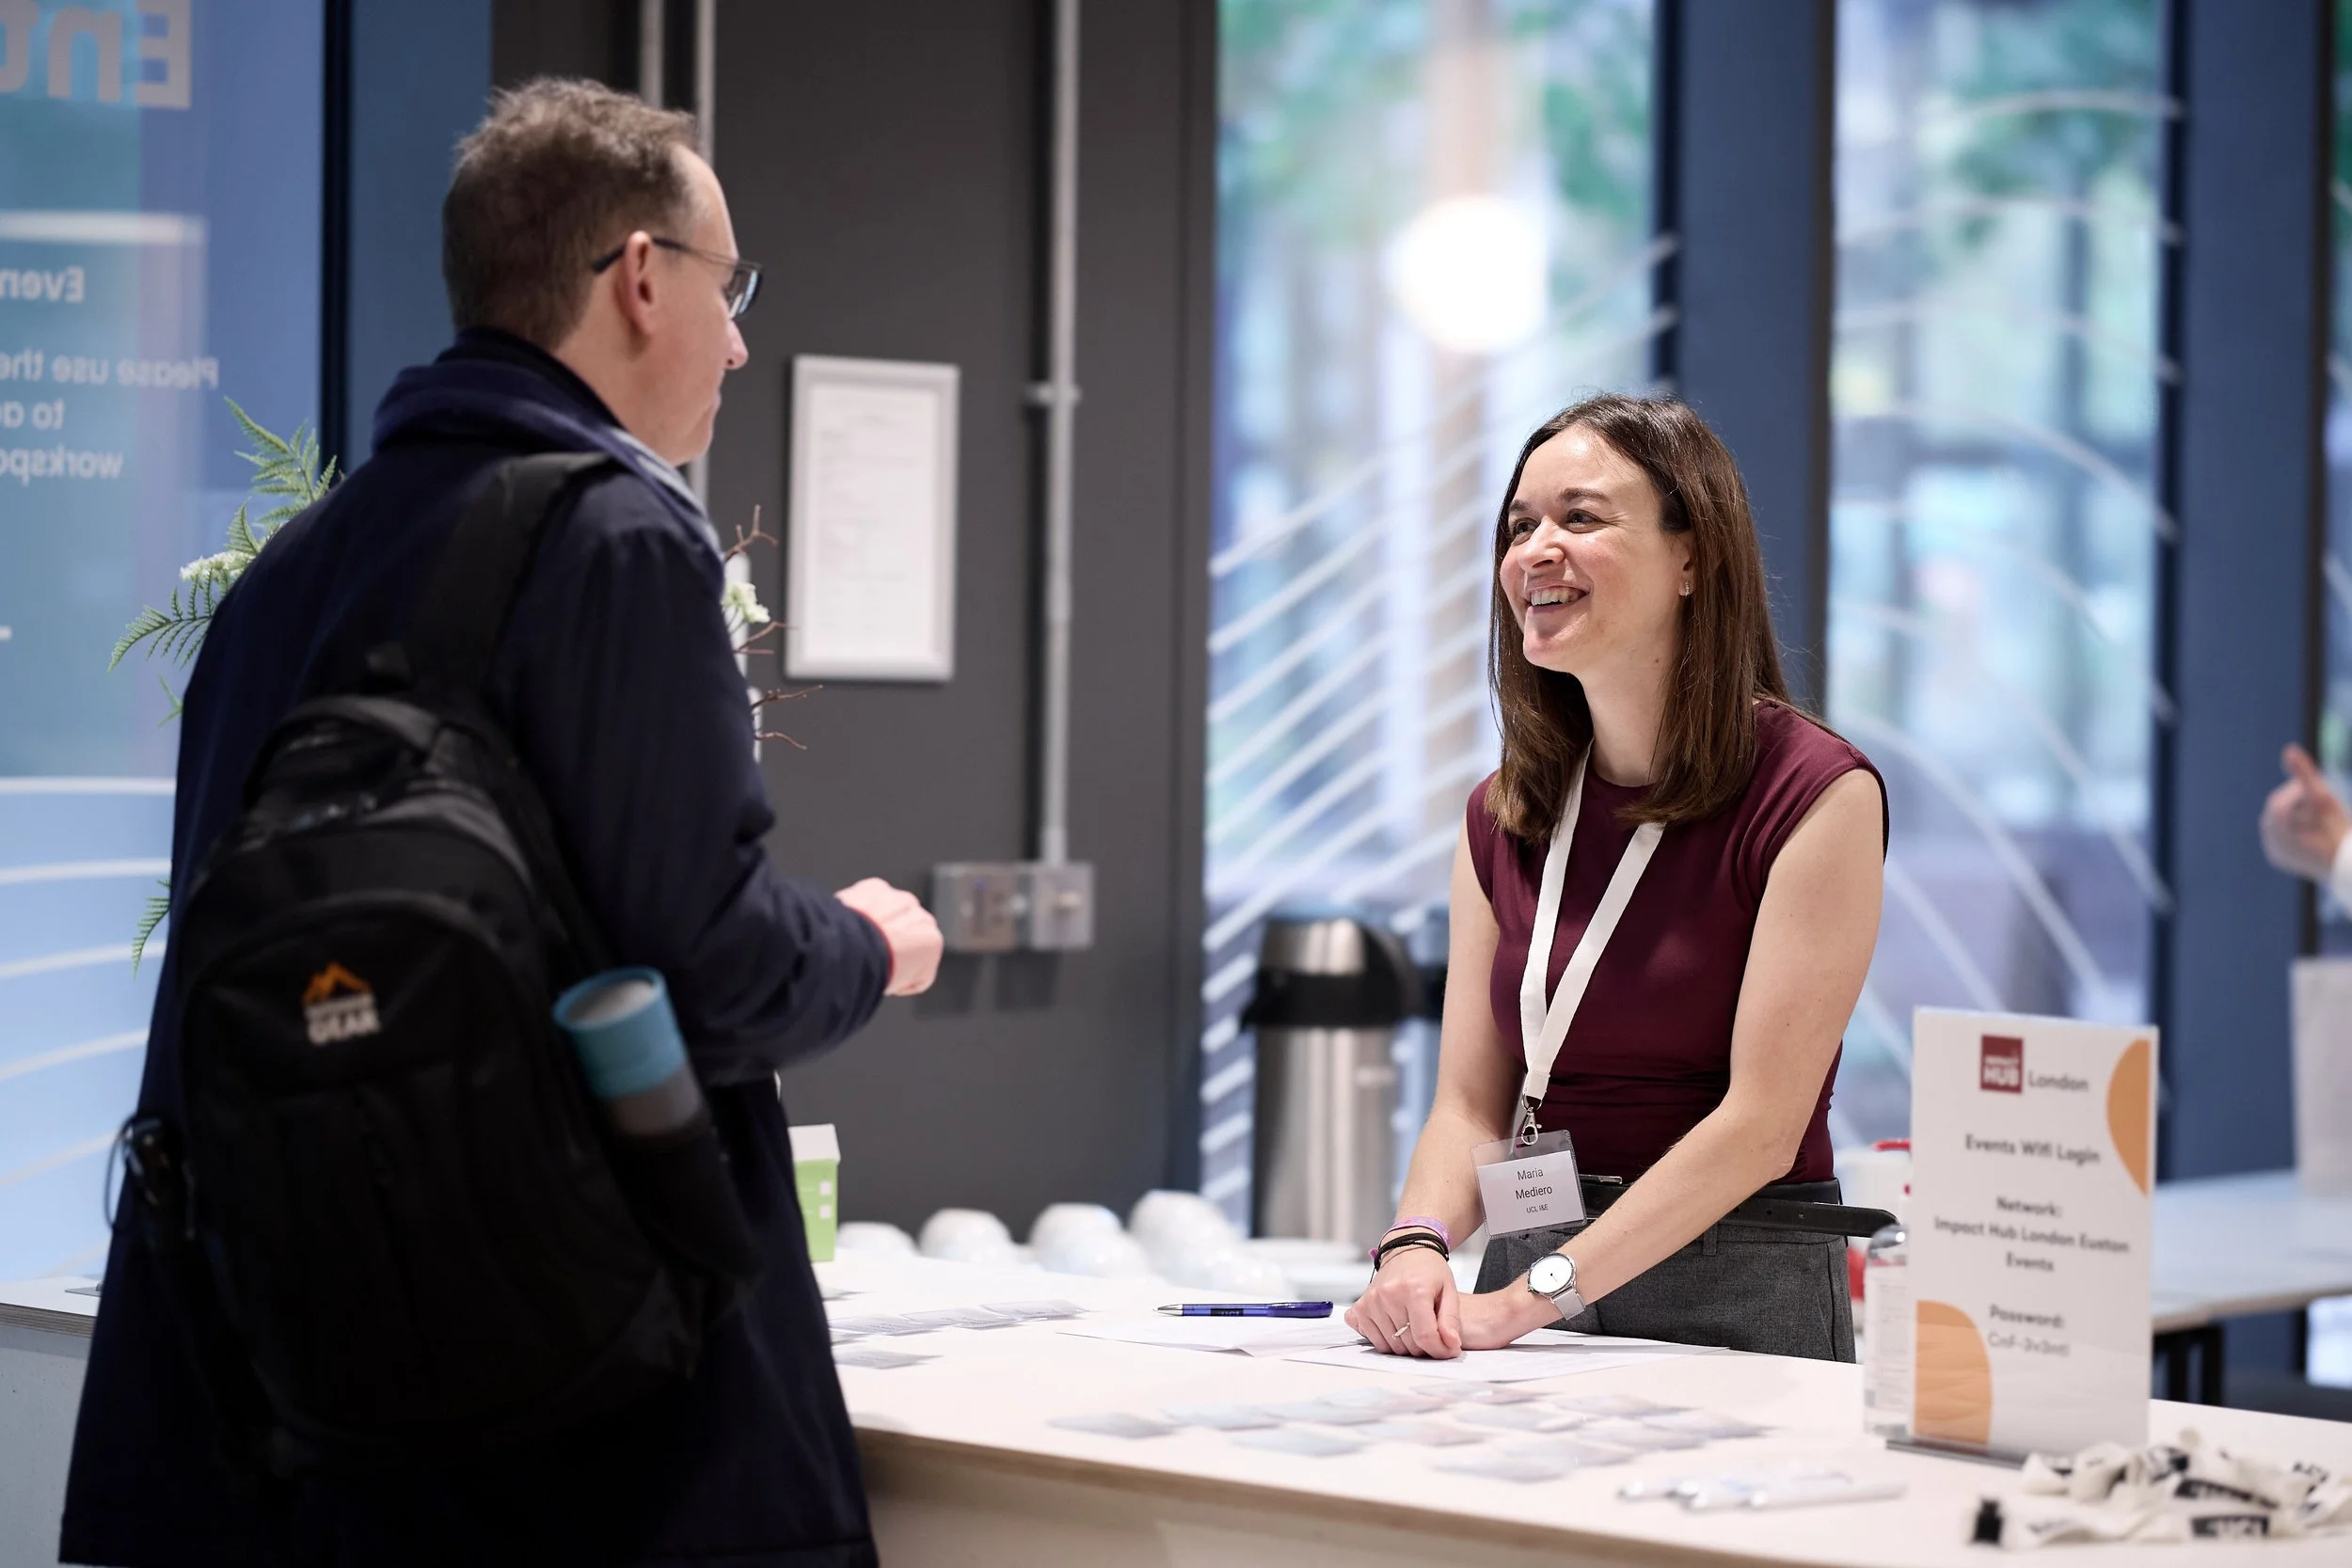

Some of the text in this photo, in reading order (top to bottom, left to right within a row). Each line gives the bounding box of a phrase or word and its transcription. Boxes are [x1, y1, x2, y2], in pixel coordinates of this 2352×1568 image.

[1984, 1067, 2020, 1087] HUB
[2028, 1070, 2089, 1091] London
[1965, 1134, 2016, 1155] Events
[2057, 1143, 2100, 1165] Login
[1517, 1167, 1544, 1180] Maria
[1515, 1185, 1553, 1199] Mediero
[1996, 1195, 2062, 1217] Network:
[1934, 1216, 2129, 1253] Impact Hub London Euston
[2006, 1251, 2055, 1272] Events
[1990, 1303, 2066, 1329] Password:
